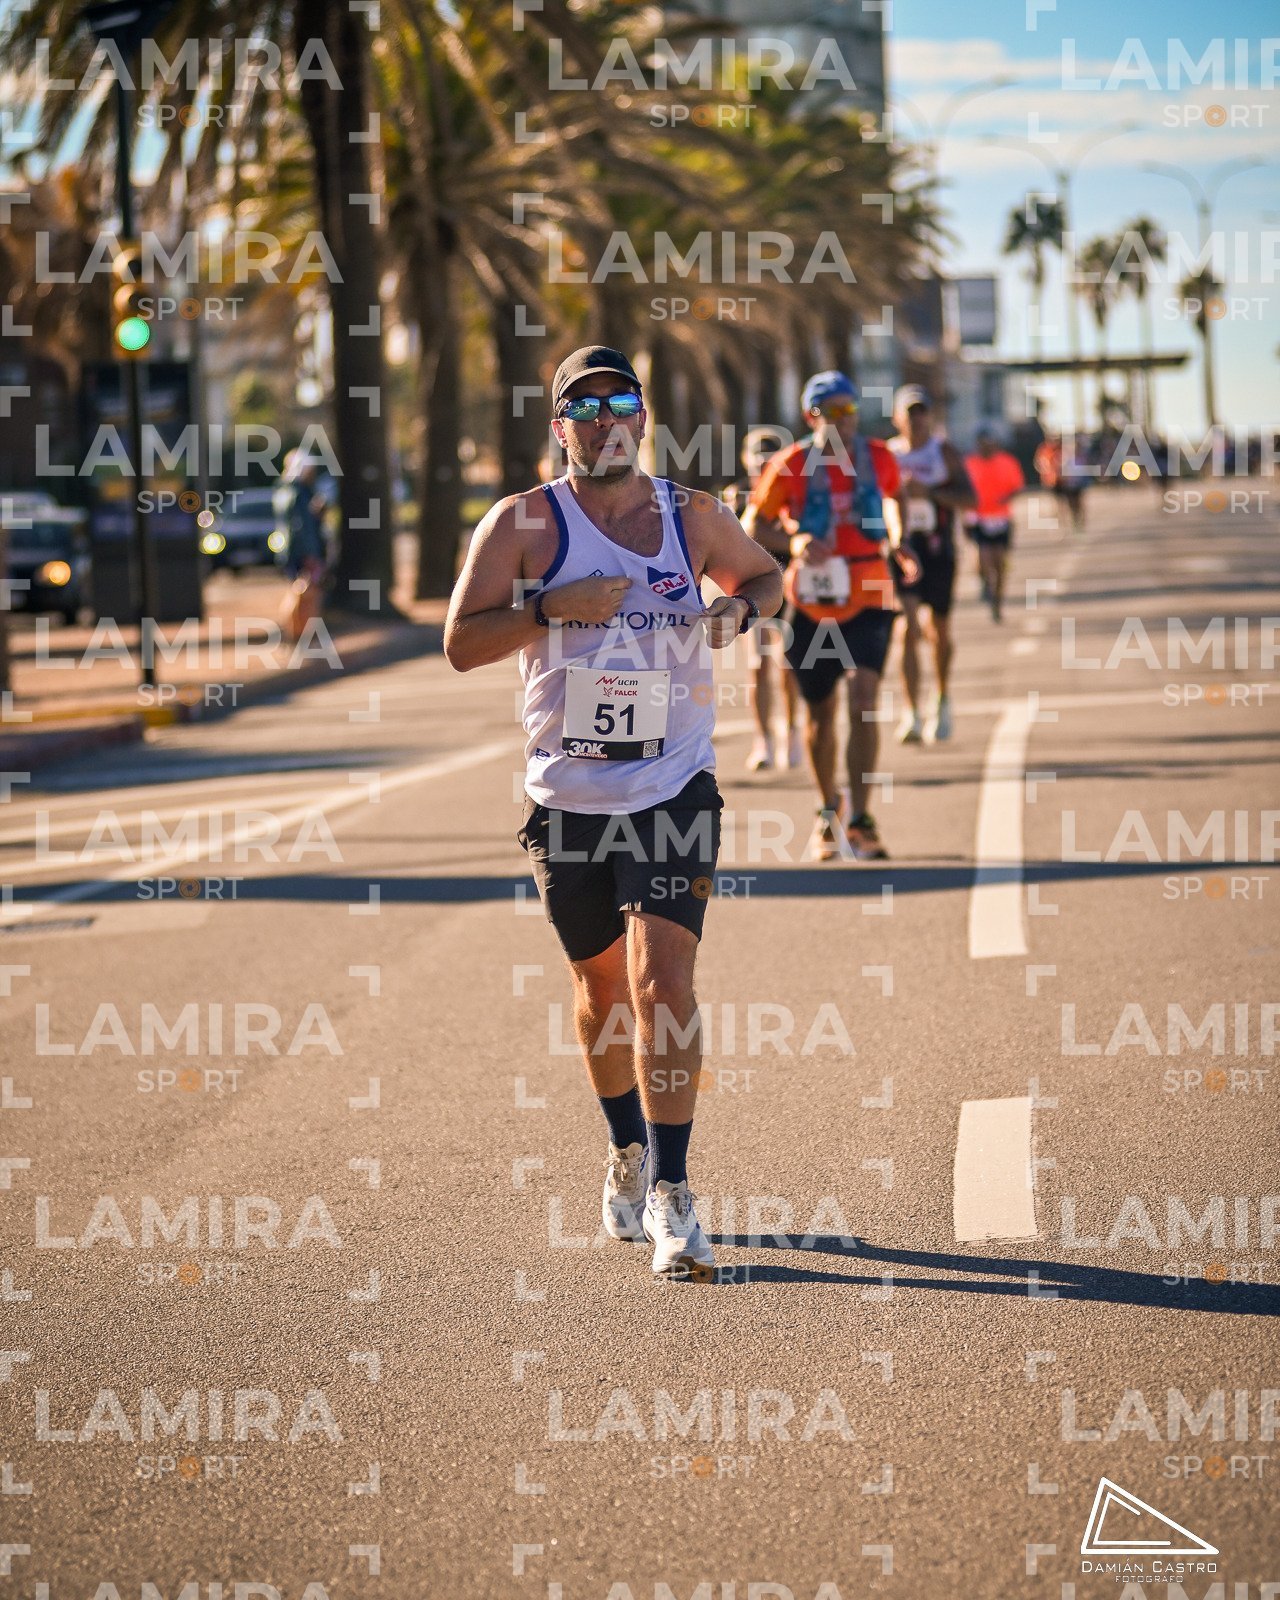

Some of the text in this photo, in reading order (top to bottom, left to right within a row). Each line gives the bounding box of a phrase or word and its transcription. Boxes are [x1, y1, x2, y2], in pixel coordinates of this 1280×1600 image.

[614, 689, 638, 697] FALCK
[593, 703, 635, 736] 51
[568, 740, 605, 757] 30K
